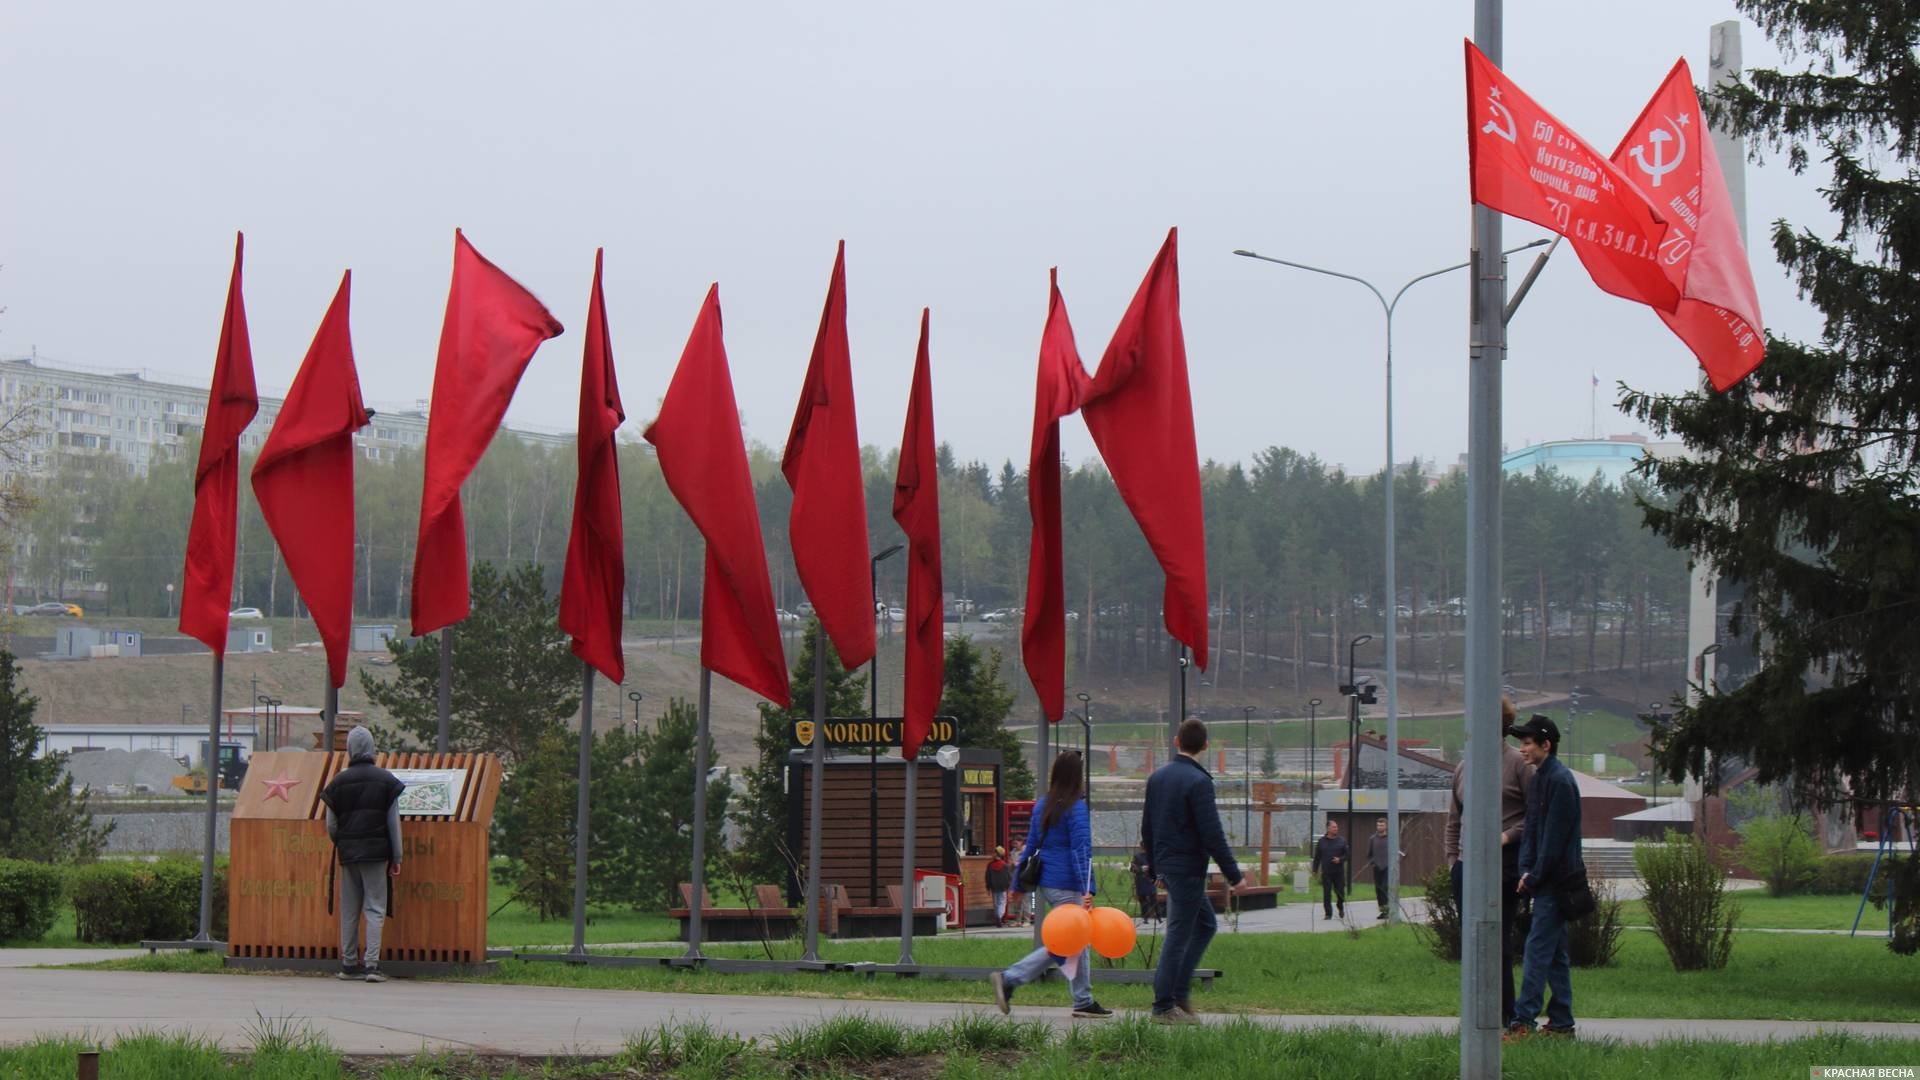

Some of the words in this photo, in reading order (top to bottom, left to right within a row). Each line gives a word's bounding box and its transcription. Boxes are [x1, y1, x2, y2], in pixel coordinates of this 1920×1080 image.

[1533, 120, 1554, 143] 150
[1659, 229, 1692, 265] 79
[824, 723, 893, 743] NORDIC
[900, 722, 952, 742] OD
